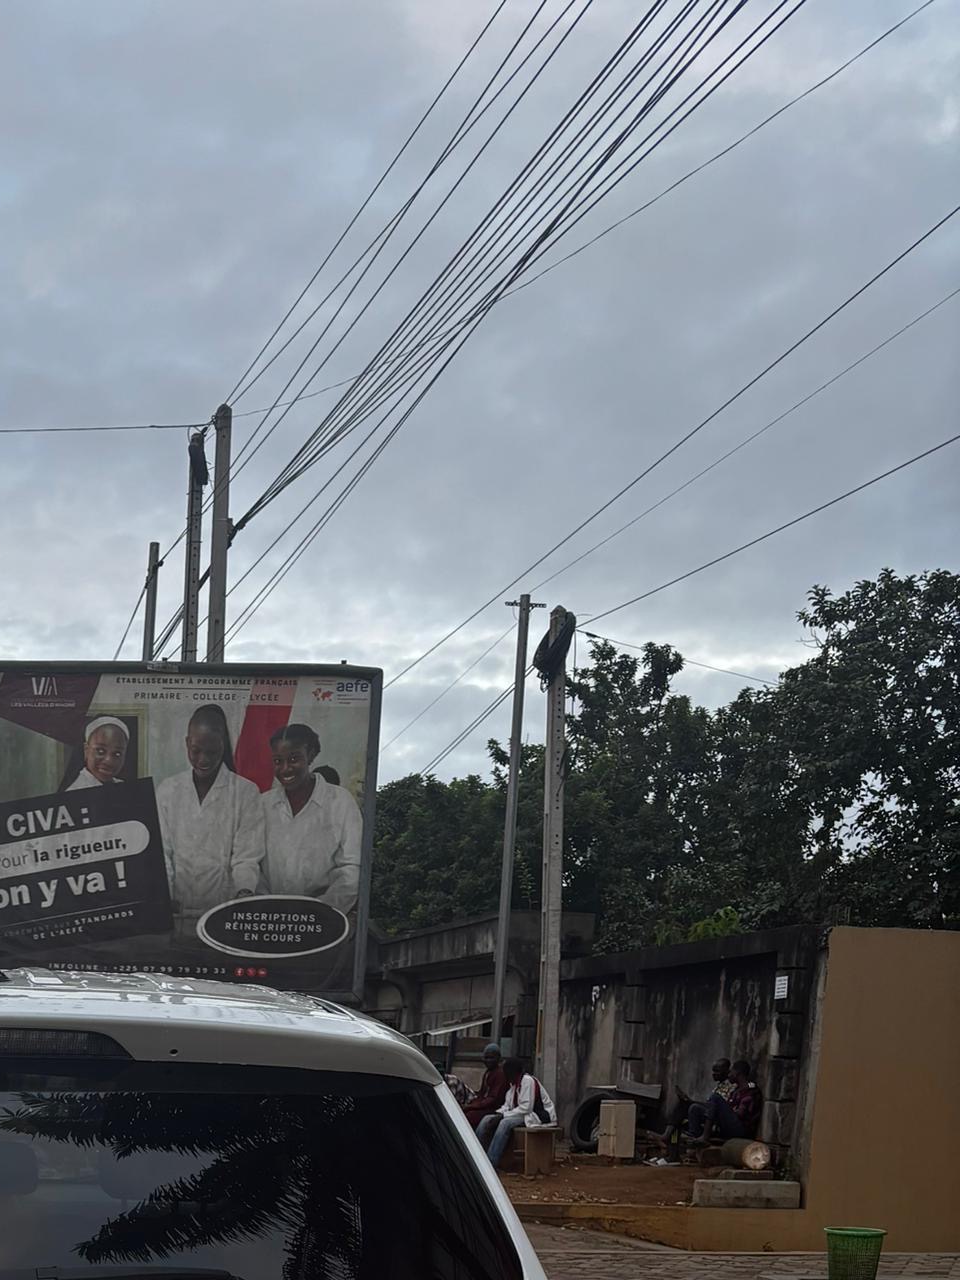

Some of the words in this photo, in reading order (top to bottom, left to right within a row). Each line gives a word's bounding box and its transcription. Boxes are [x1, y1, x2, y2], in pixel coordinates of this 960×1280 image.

[115, 676, 185, 686] ÉTABLISSEMENT
[188, 676, 194, 685] À
[197, 678, 251, 687] PROGRAMME
[254, 679, 298, 688] FRANÇAIS
[336, 679, 369, 693] aefe
[134, 691, 182, 700] PRIMAIRE
[192, 691, 237, 701] COLLÈGE
[249, 693, 279, 702] LYCÉE
[6, 805, 75, 837] CIVA
[33, 849, 50, 863] la
[55, 837, 128, 860] rigueur,
[38, 879, 59, 908] y
[65, 871, 107, 896] va
[114, 860, 128, 889] !
[73, 909, 135, 926] STANDARDS
[232, 911, 316, 922] INSCRIPTIONS
[32, 932, 46, 941] DE
[50, 925, 84, 938] L'AEFE
[224, 921, 323, 933] RÉINSCRIPTIONS
[243, 932, 259, 942] EN
[263, 933, 302, 943] COURS
[48, 963, 99, 971] INFOLINE
